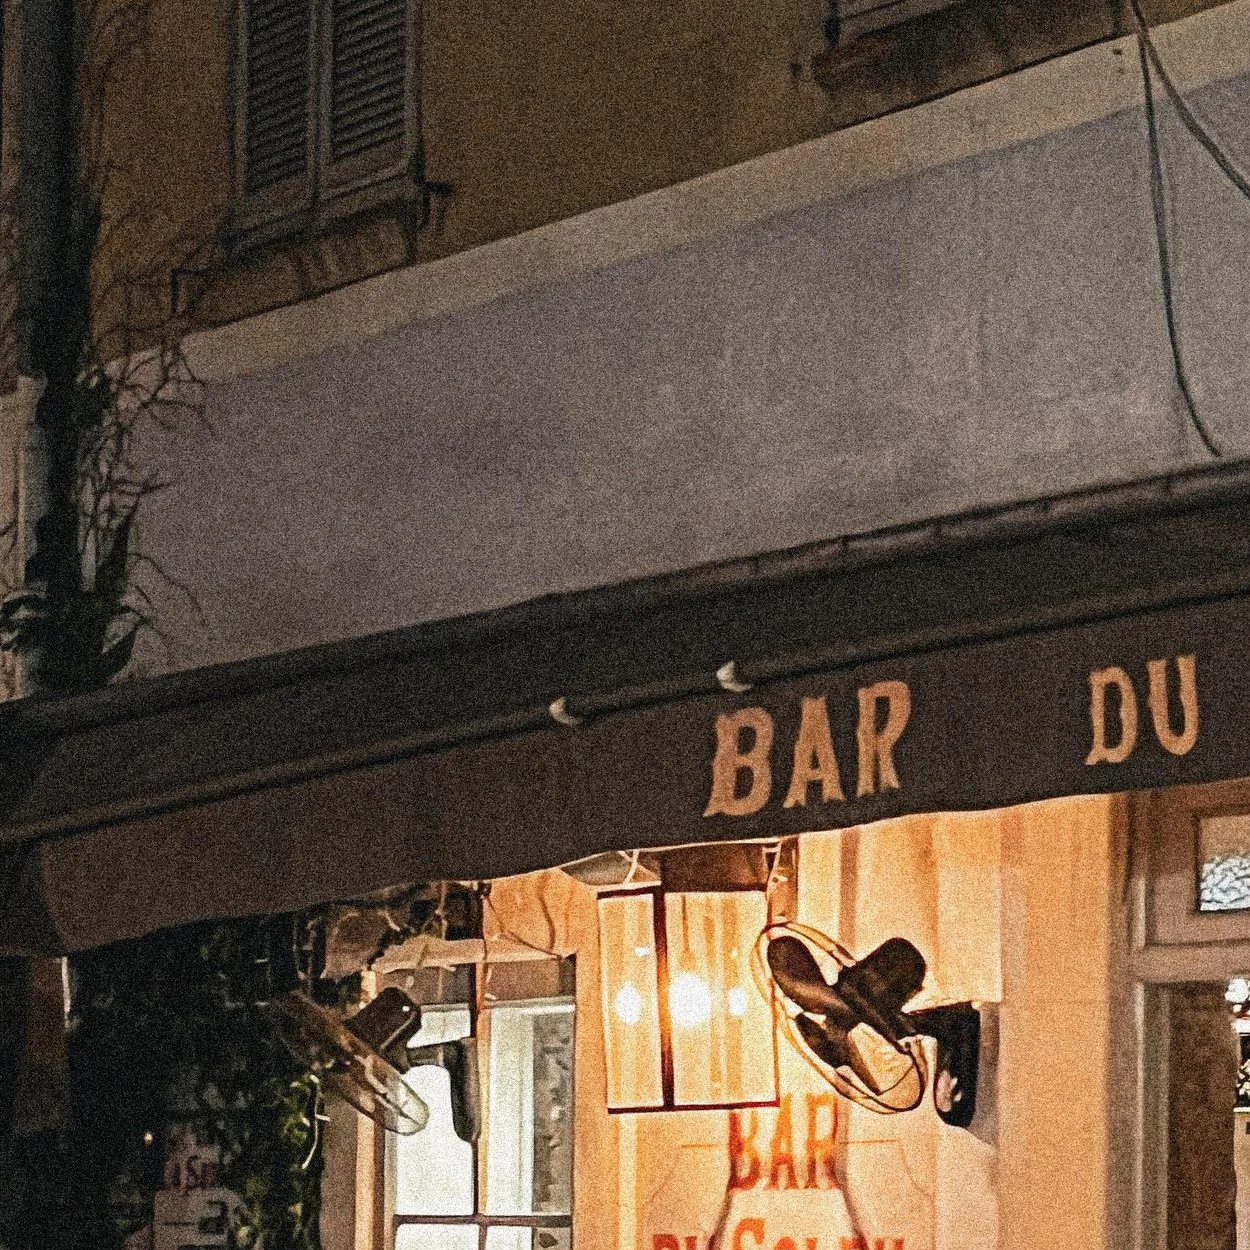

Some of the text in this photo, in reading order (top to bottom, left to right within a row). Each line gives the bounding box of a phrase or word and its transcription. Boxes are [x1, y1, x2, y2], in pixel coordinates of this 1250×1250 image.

[702, 680, 912, 818] BAR
[1084, 654, 1200, 766] DU
[728, 1092, 843, 1191] BAR
